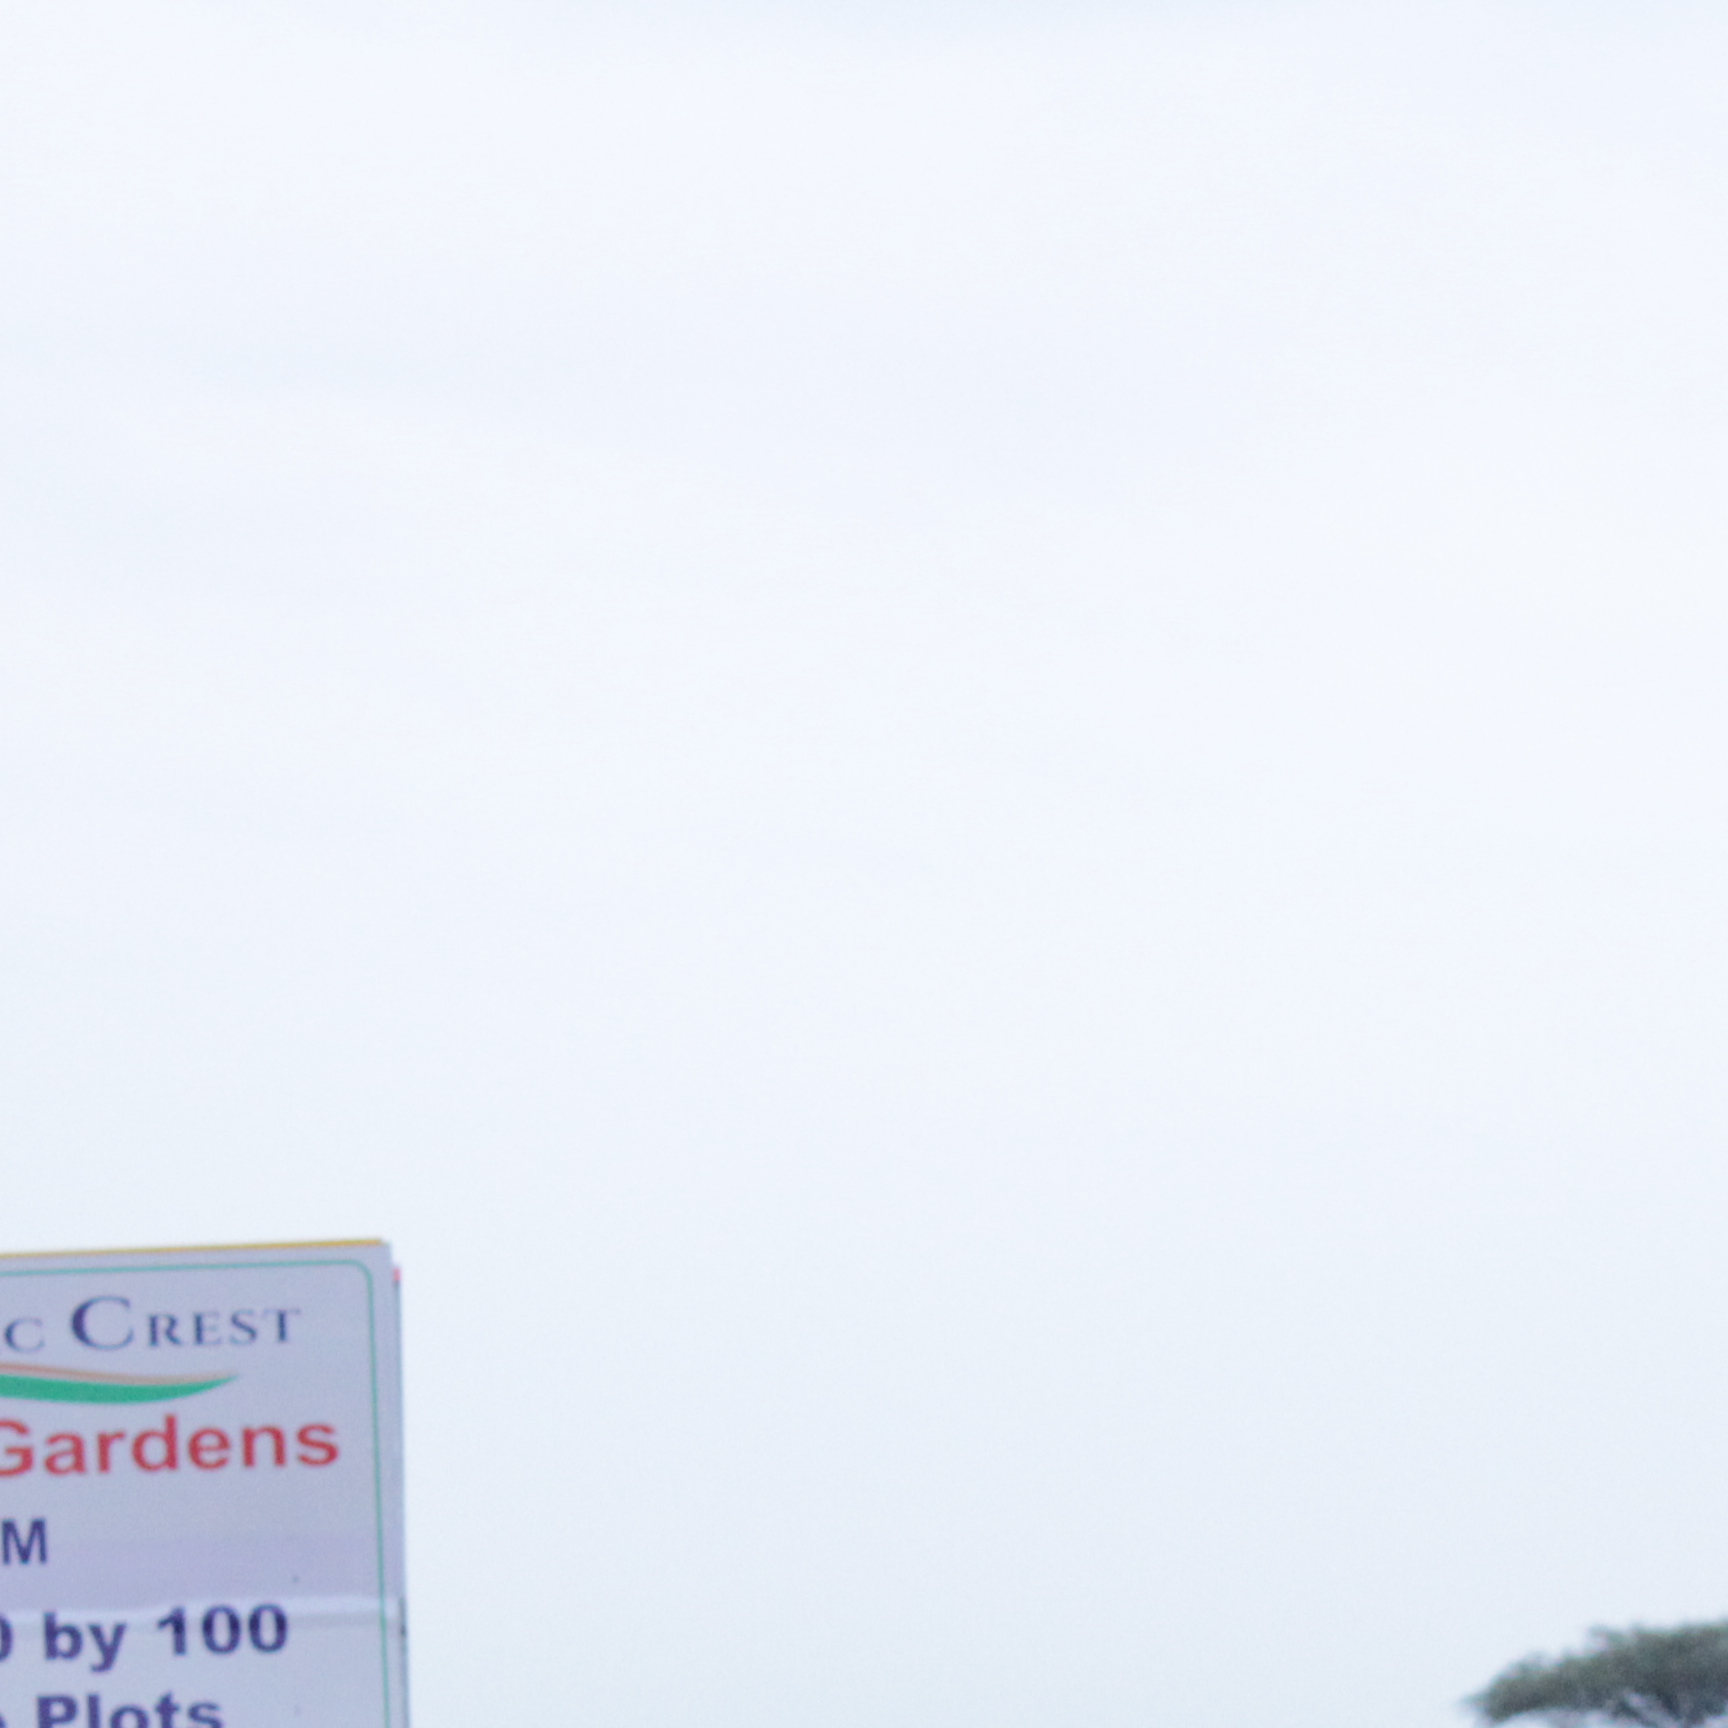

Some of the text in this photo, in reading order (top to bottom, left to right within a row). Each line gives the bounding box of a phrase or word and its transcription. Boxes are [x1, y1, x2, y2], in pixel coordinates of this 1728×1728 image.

[69, 1296, 300, 1350] CREST
[42, 1611, 127, 1674] by
[156, 1603, 290, 1656] 100
